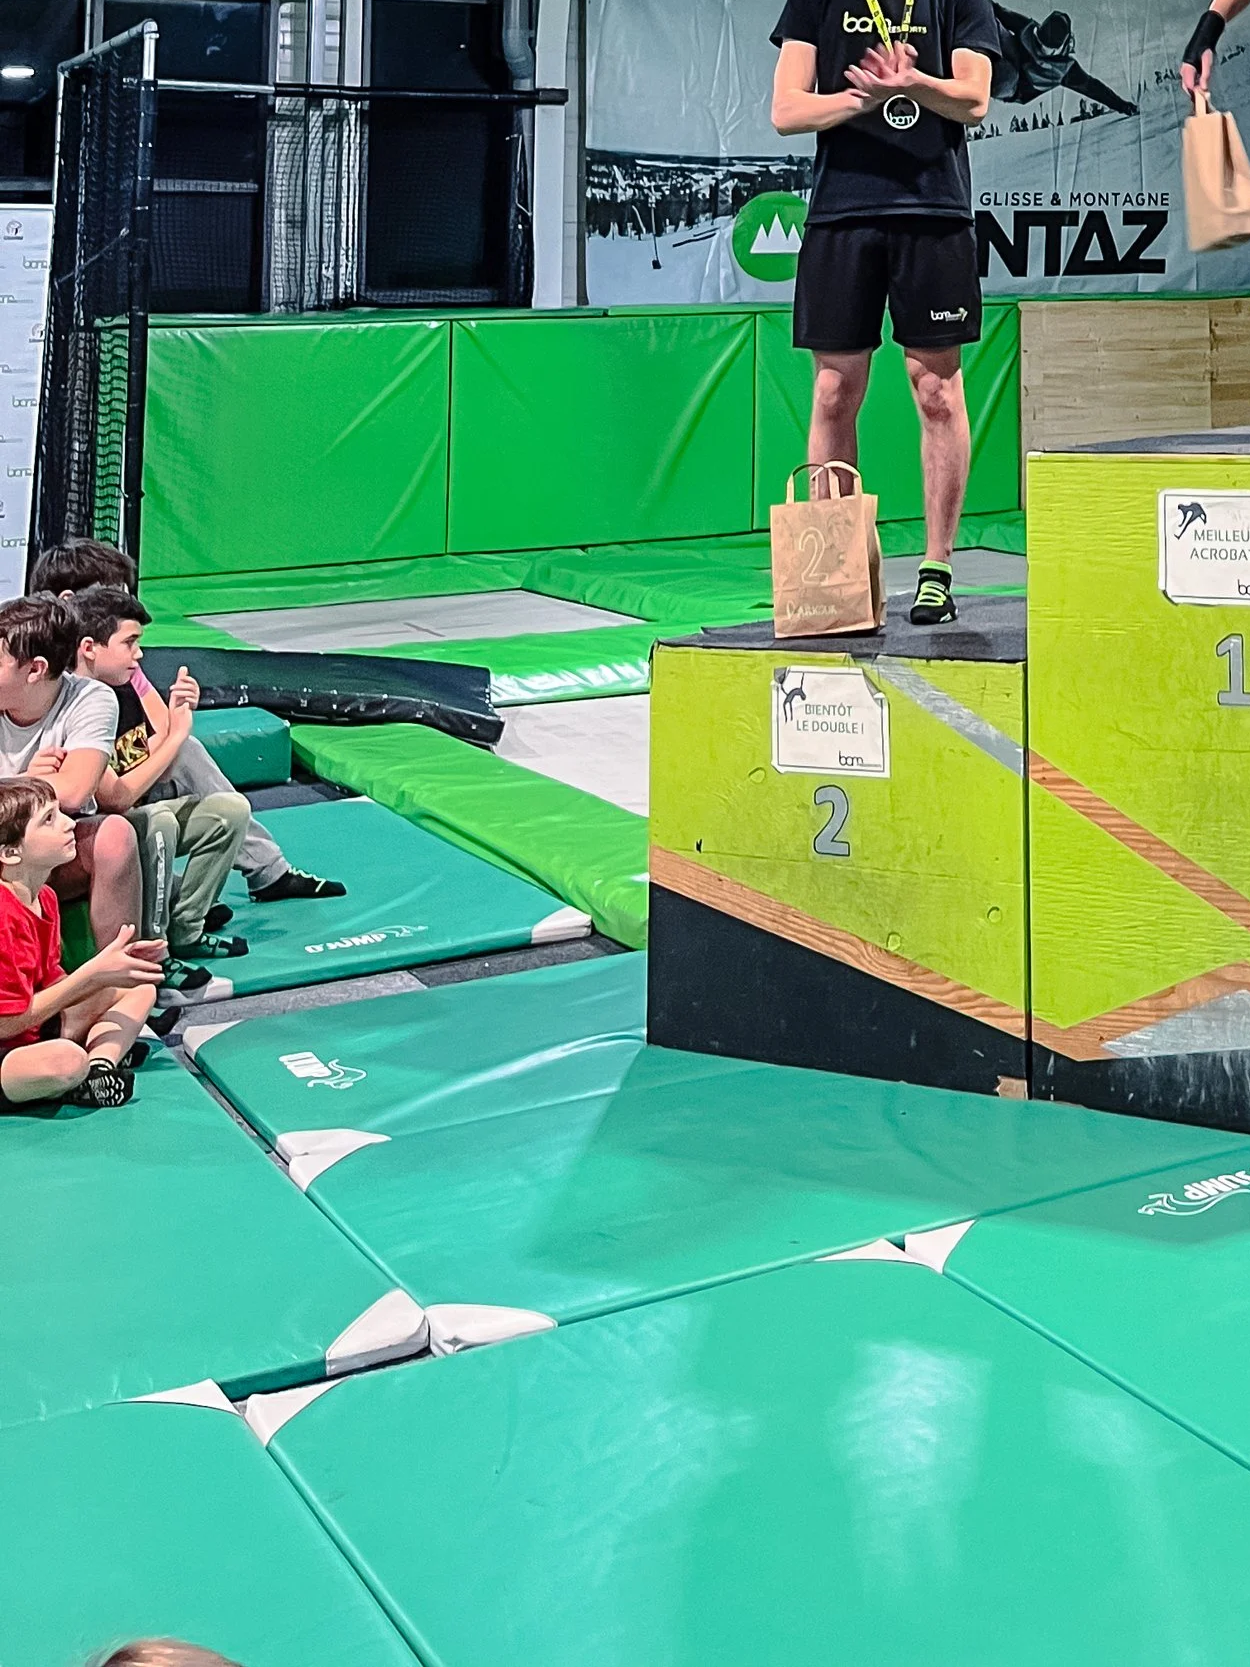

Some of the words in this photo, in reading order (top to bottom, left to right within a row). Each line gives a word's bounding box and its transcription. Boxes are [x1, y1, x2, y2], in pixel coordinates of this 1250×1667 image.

[979, 192, 1043, 207] GLISSE
[1050, 192, 1061, 206] &
[1069, 192, 1170, 207] MONTAGNE
[798, 526, 829, 586] 2
[804, 702, 853, 717] BIENTÔT
[796, 719, 809, 732] LE
[811, 720, 859, 734] DOUBLE
[838, 750, 864, 767] bam
[814, 784, 851, 857] 2
